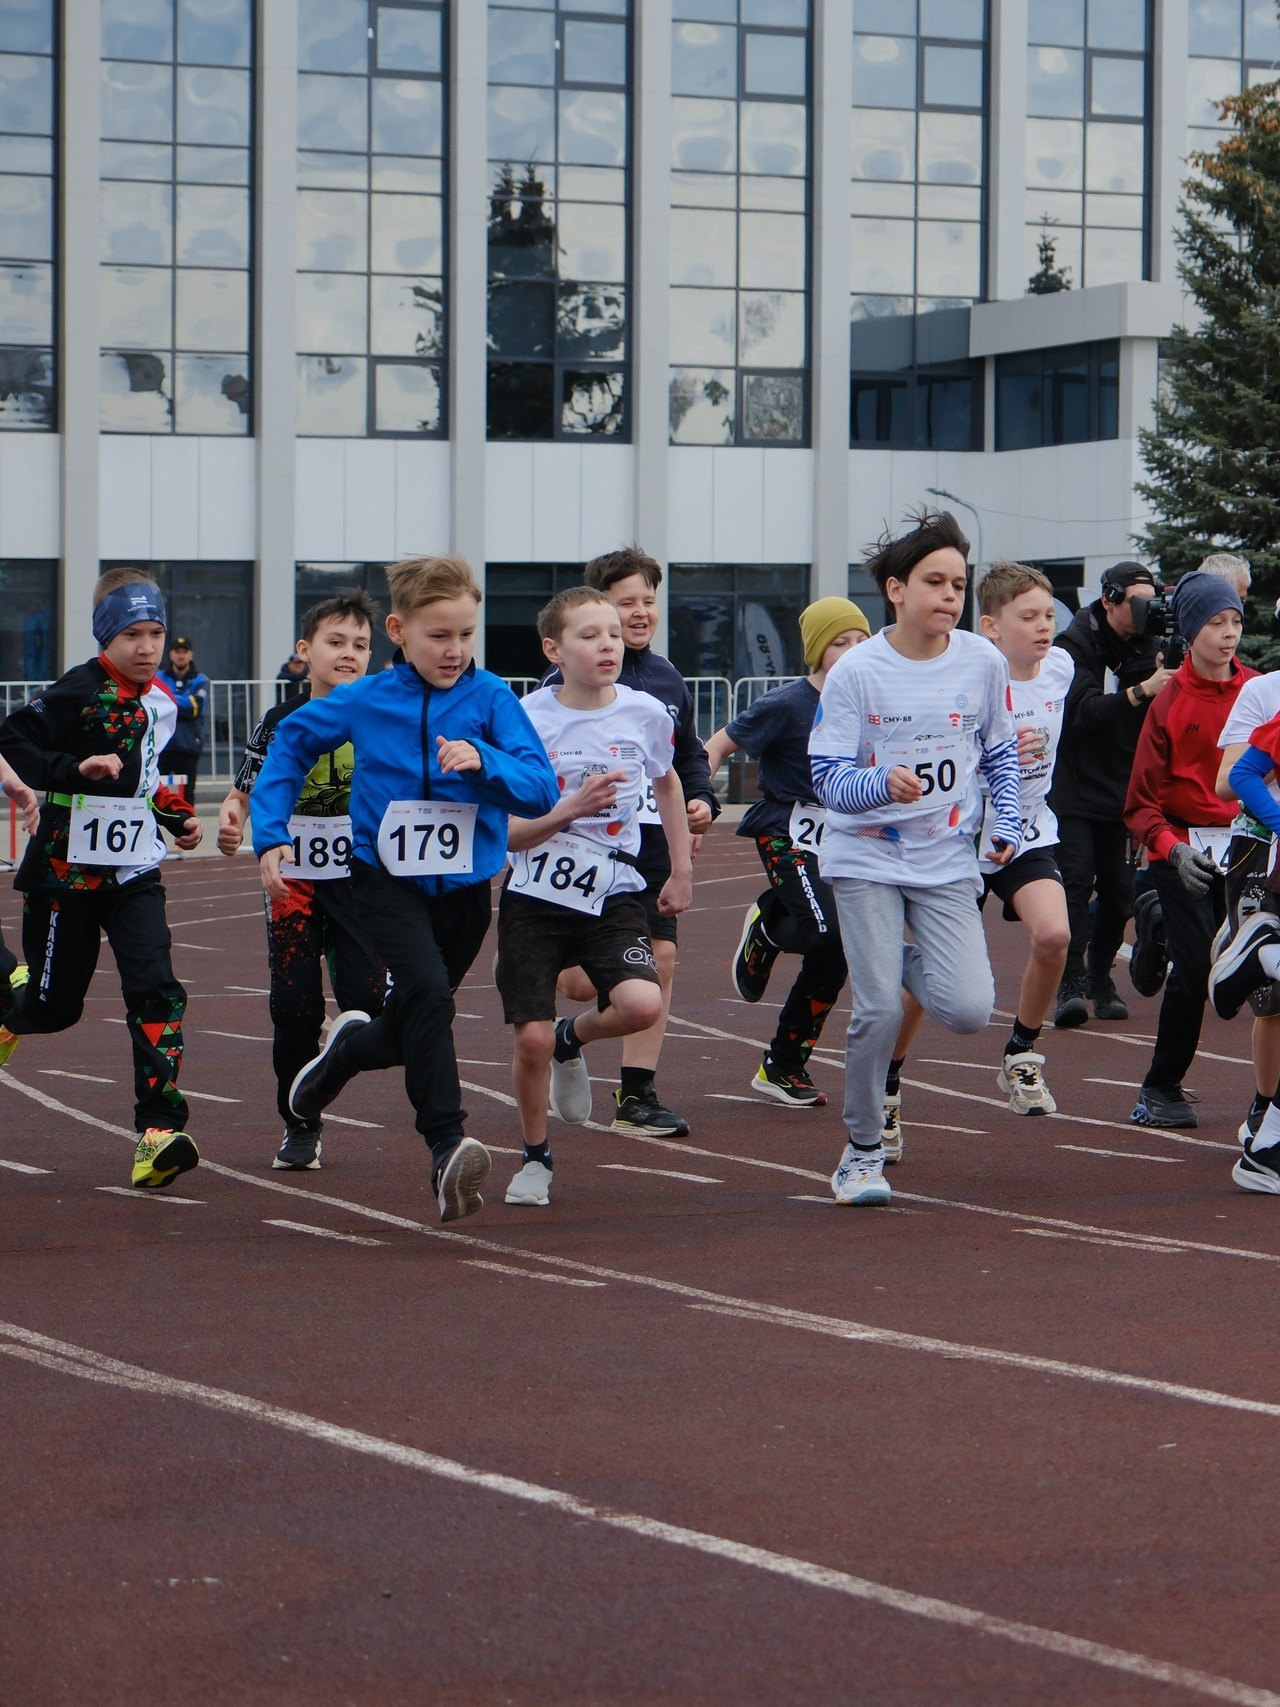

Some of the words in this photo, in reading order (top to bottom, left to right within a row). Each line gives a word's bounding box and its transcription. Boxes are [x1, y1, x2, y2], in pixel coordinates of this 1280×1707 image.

[1014, 710, 1035, 721] МУ-88
[83, 817, 145, 853] 167
[292, 835, 351, 868] 189
[389, 823, 460, 862] 179
[531, 851, 599, 898] 184
[797, 865, 828, 933] КАЗАНЬ
[39, 910, 59, 1002] КАЗАНЬ
